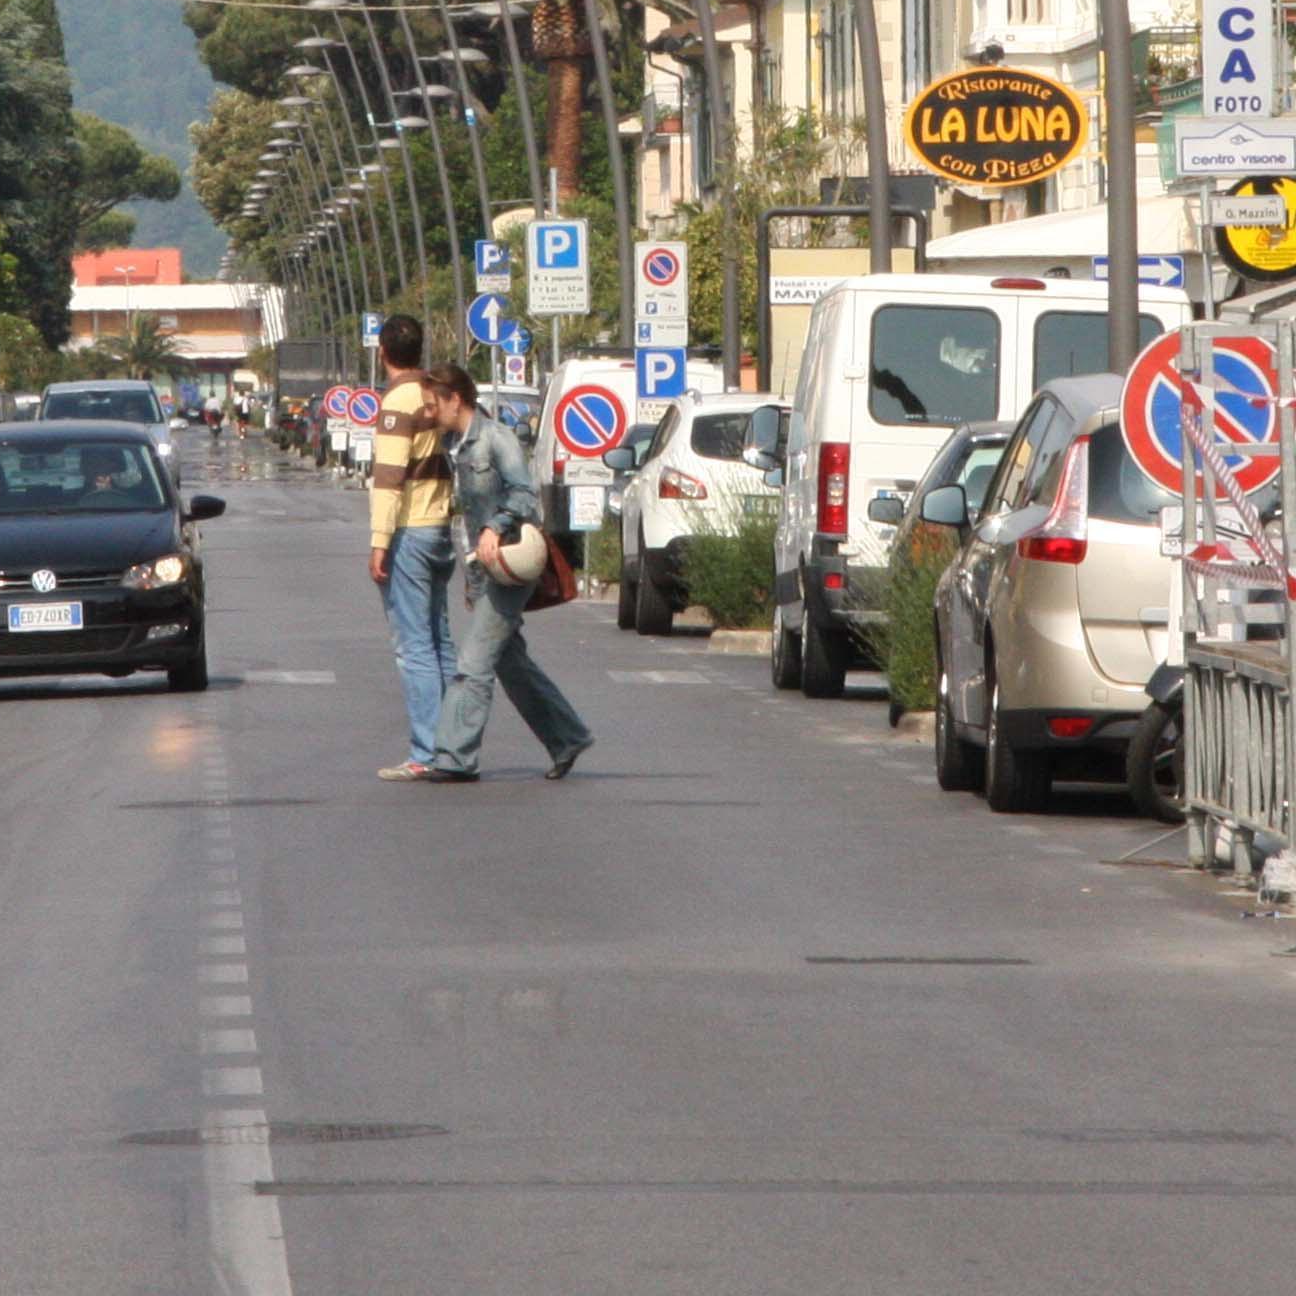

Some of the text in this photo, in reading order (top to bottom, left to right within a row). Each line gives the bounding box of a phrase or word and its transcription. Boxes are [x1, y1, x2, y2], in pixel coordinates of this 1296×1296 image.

[938, 78, 1053, 101] Ristorante
[1214, 95, 1262, 113] FOTO
[921, 105, 1071, 143] LA LUNA
[940, 152, 1057, 183] con Pizza
[1191, 153, 1287, 165] centro visione
[1239, 208, 1279, 218] Mazzini
[544, 230, 571, 265] P
[645, 354, 676, 394] P
